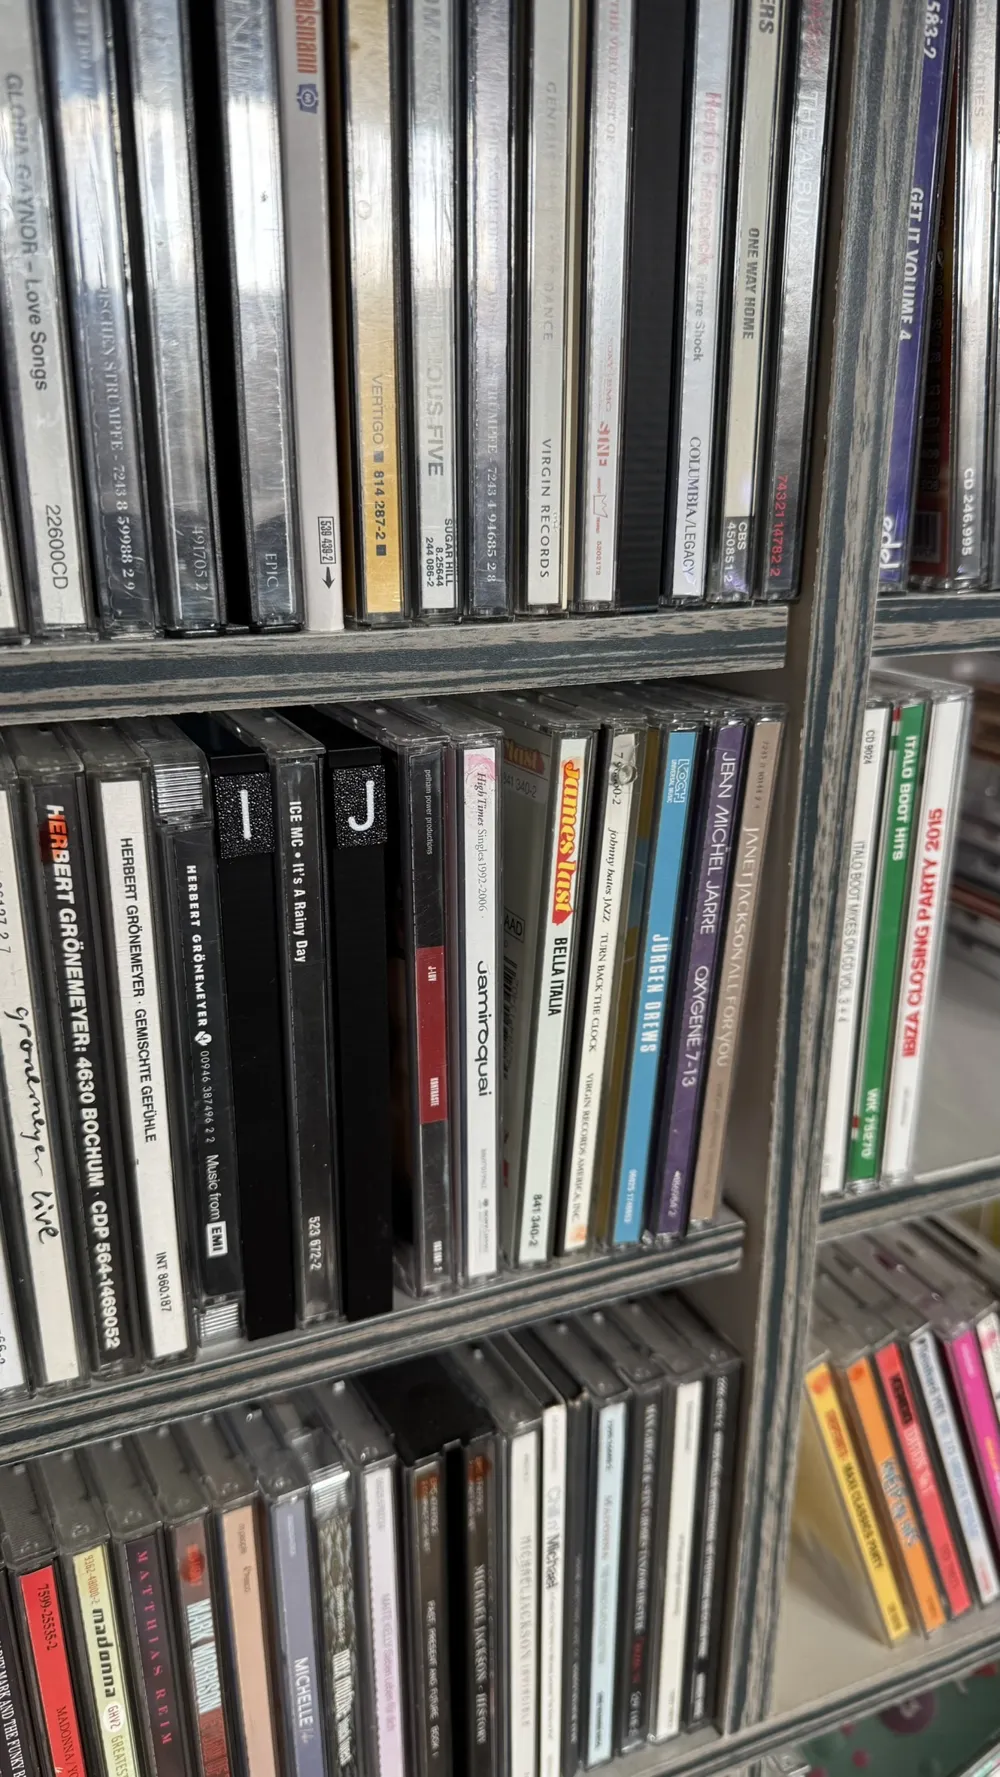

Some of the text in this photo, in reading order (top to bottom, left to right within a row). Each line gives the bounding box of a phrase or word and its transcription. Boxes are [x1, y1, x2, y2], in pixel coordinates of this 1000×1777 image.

[17, 163, 39, 255] GAYNOR
[742, 227, 762, 340] ONE WAY HOME
[899, 187, 925, 341] GET IT VOLUME 4
[24, 278, 42, 325] Love
[29, 331, 49, 392] Songs
[692, 322, 707, 363] Shock
[371, 374, 386, 445] VERTIGO
[427, 425, 445, 477] FIVE
[112, 465, 136, 591] 7243 8 59988 2 9
[373, 470, 387, 541] 814 287-2
[486, 467, 499, 583] 7243 4 94685 2 8
[539, 437, 554, 579] VIRGIN RECORDS
[681, 436, 703, 578] COLUMBIA/LEGACY
[736, 521, 749, 551] CBS
[769, 475, 790, 577] 74321 14782 2
[961, 467, 976, 556] CD 246.995
[45, 504, 71, 591] 22600CD
[190, 526, 208, 591] 491705 2
[264, 552, 280, 589] EPIC
[320, 520, 336, 562] 539 439-2
[425, 536, 437, 588] 244 086-2
[435, 547, 446, 588] 8.25644
[444, 517, 455, 587] SUGAR HILL
[724, 521, 737, 583] 450851 2
[673, 758, 692, 804] KOCH
[862, 729, 878, 766] CD 9024
[288, 800, 304, 823] ICE
[347, 780, 377, 832] J
[423, 769, 437, 856] pelham power productions
[892, 734, 919, 862] ITALO BOOT HITS
[289, 826, 305, 848] MC
[474, 772, 490, 912] High Times Singles 1992-2006
[553, 761, 582, 918] James last
[850, 840, 868, 871] ITALO
[292, 901, 310, 937] Rainy
[293, 888, 306, 898] A
[602, 897, 615, 923] JAZZ
[681, 751, 738, 1088] JEAN MICHEL JARRE OXYGENE 7-13
[848, 872, 864, 902] BOOT
[294, 940, 310, 963] Day
[597, 932, 611, 963] TURN
[716, 827, 762, 1067] JANET JACKSON ALL FOR YOU
[901, 807, 943, 1058] IBIZA CLOSING PARTY 2015
[120, 837, 159, 1143] HERBERT GRÖNEMEYER GEMISCHTE GEFÜHLE
[186, 865, 217, 1145] HERBERT GRÖNEMEYER 00946 387496 2 2
[547, 936, 570, 1017] BELLA ITALIA
[591, 993, 606, 1016] THE
[594, 964, 607, 993] BACK
[639, 933, 672, 1054] JÜRGEN DREWS
[474, 960, 494, 1098] Jamiroquai
[588, 1017, 602, 1053] CLOCK
[46, 803, 122, 1350] HERBERT GRÖNEMEYER: 4630 BOCHUM CDP 564-1469052
[864, 1087, 881, 1112] WK
[577, 1072, 597, 1156] VIRGIN RECORDS
[30, 1189, 60, 1246] live
[206, 1154, 224, 1253] Music from EMI
[529, 1194, 545, 1248] 841 340-2
[308, 1216, 324, 1272] 523 672-2
[155, 1251, 173, 1313] INT 860.187
[35, 1583, 60, 1653] 7599-25535-2
[186, 1598, 215, 1643] MARK
[473, 1563, 487, 1626] MICHAEL
[91, 1607, 119, 1699] madonna
[107, 1704, 122, 1731] GHV2
[136, 1549, 173, 1745] MATTHIAS REIM
[190, 1640, 223, 1714] MORRISON
[293, 1655, 316, 1727] MICHELLE
[1, 1700, 25, 1769] AND THE FUNKY
[56, 1705, 77, 1761] MADONNA
